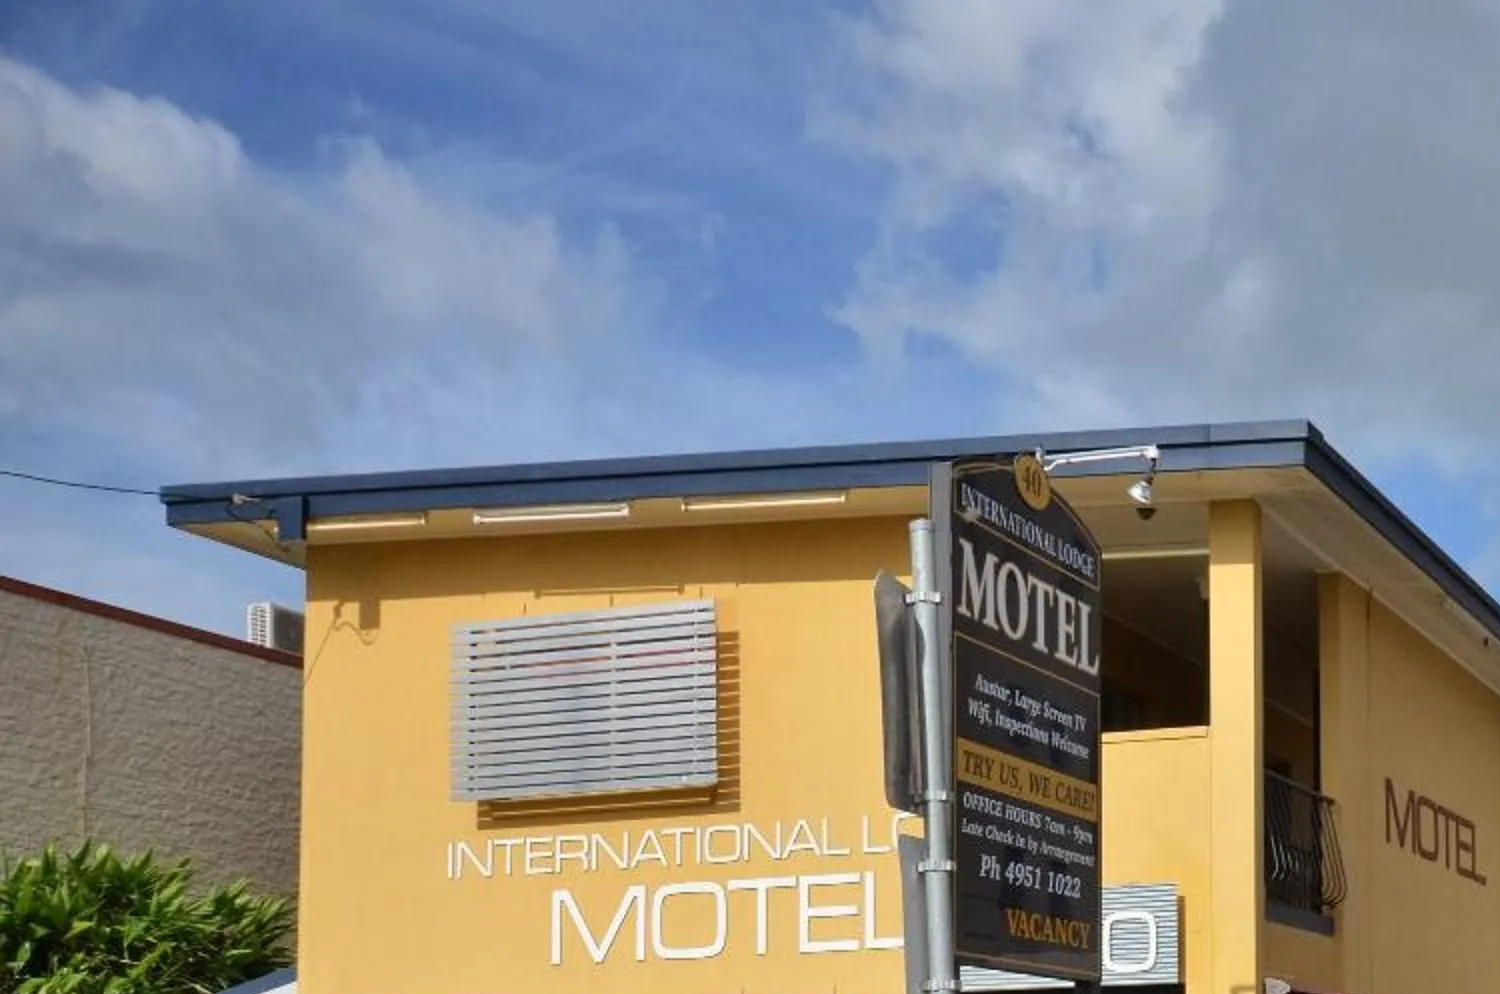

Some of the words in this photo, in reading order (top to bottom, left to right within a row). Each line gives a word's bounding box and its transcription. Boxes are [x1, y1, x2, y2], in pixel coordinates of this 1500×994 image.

[961, 482, 1057, 557] INTERNATIONAL
[1057, 537, 1096, 578] LODGE
[956, 537, 1100, 676] MOTEL
[1015, 689, 1042, 718] Large
[1043, 700, 1074, 729] Screen
[1074, 713, 1088, 732] TV
[1051, 729, 1090, 760] Welcome
[962, 749, 996, 781] TRY
[999, 761, 1023, 794] US,
[1028, 771, 1051, 800] WE
[961, 818, 983, 838] Late
[985, 824, 1015, 846] Check
[1027, 835, 1039, 857] by
[962, 791, 1004, 817] OFFICE
[1005, 803, 1042, 829] HOURS
[1044, 815, 1066, 836] 7am
[1384, 775, 1487, 887] MOTEL
[446, 818, 850, 880] INTERNATIONAL
[979, 853, 1001, 881] Ph
[1005, 860, 1041, 891] 4951
[1047, 871, 1082, 899] 1022
[550, 869, 905, 966] MOTEL
[1005, 907, 1091, 950] VACANCY
